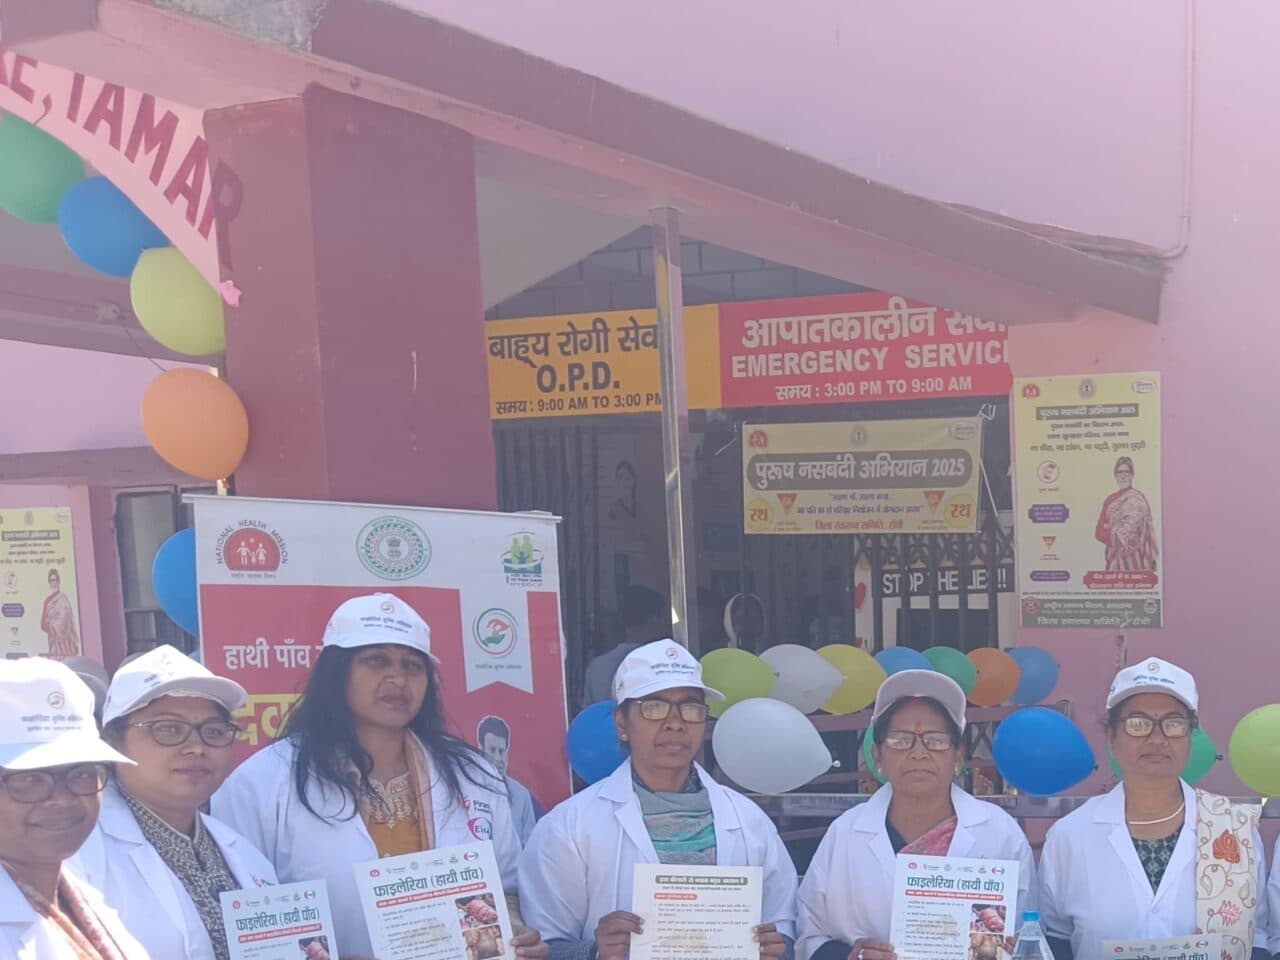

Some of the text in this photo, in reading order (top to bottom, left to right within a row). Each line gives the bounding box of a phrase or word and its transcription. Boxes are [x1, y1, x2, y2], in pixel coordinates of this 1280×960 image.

[557, 317, 609, 356] रोगी
[617, 316, 659, 351] सेव
[742, 296, 937, 348] आपातकालीन
[536, 362, 620, 393] O.P.D.
[732, 347, 888, 378] EMERGENCY
[496, 400, 528, 414] समय
[538, 399, 564, 412] 9:00
[568, 397, 588, 410] AM
[592, 396, 609, 408] TO
[614, 393, 641, 407] 3:00
[776, 376, 971, 400] समय 3:00 PM TO 9:00 AM
[798, 454, 856, 480] नसबंदी
[859, 453, 928, 479] अभियान
[931, 457, 965, 476] 2025
[216, 520, 288, 565] NATIONAL HEALTH MISSION
[223, 638, 310, 670] हाथी पाँव
